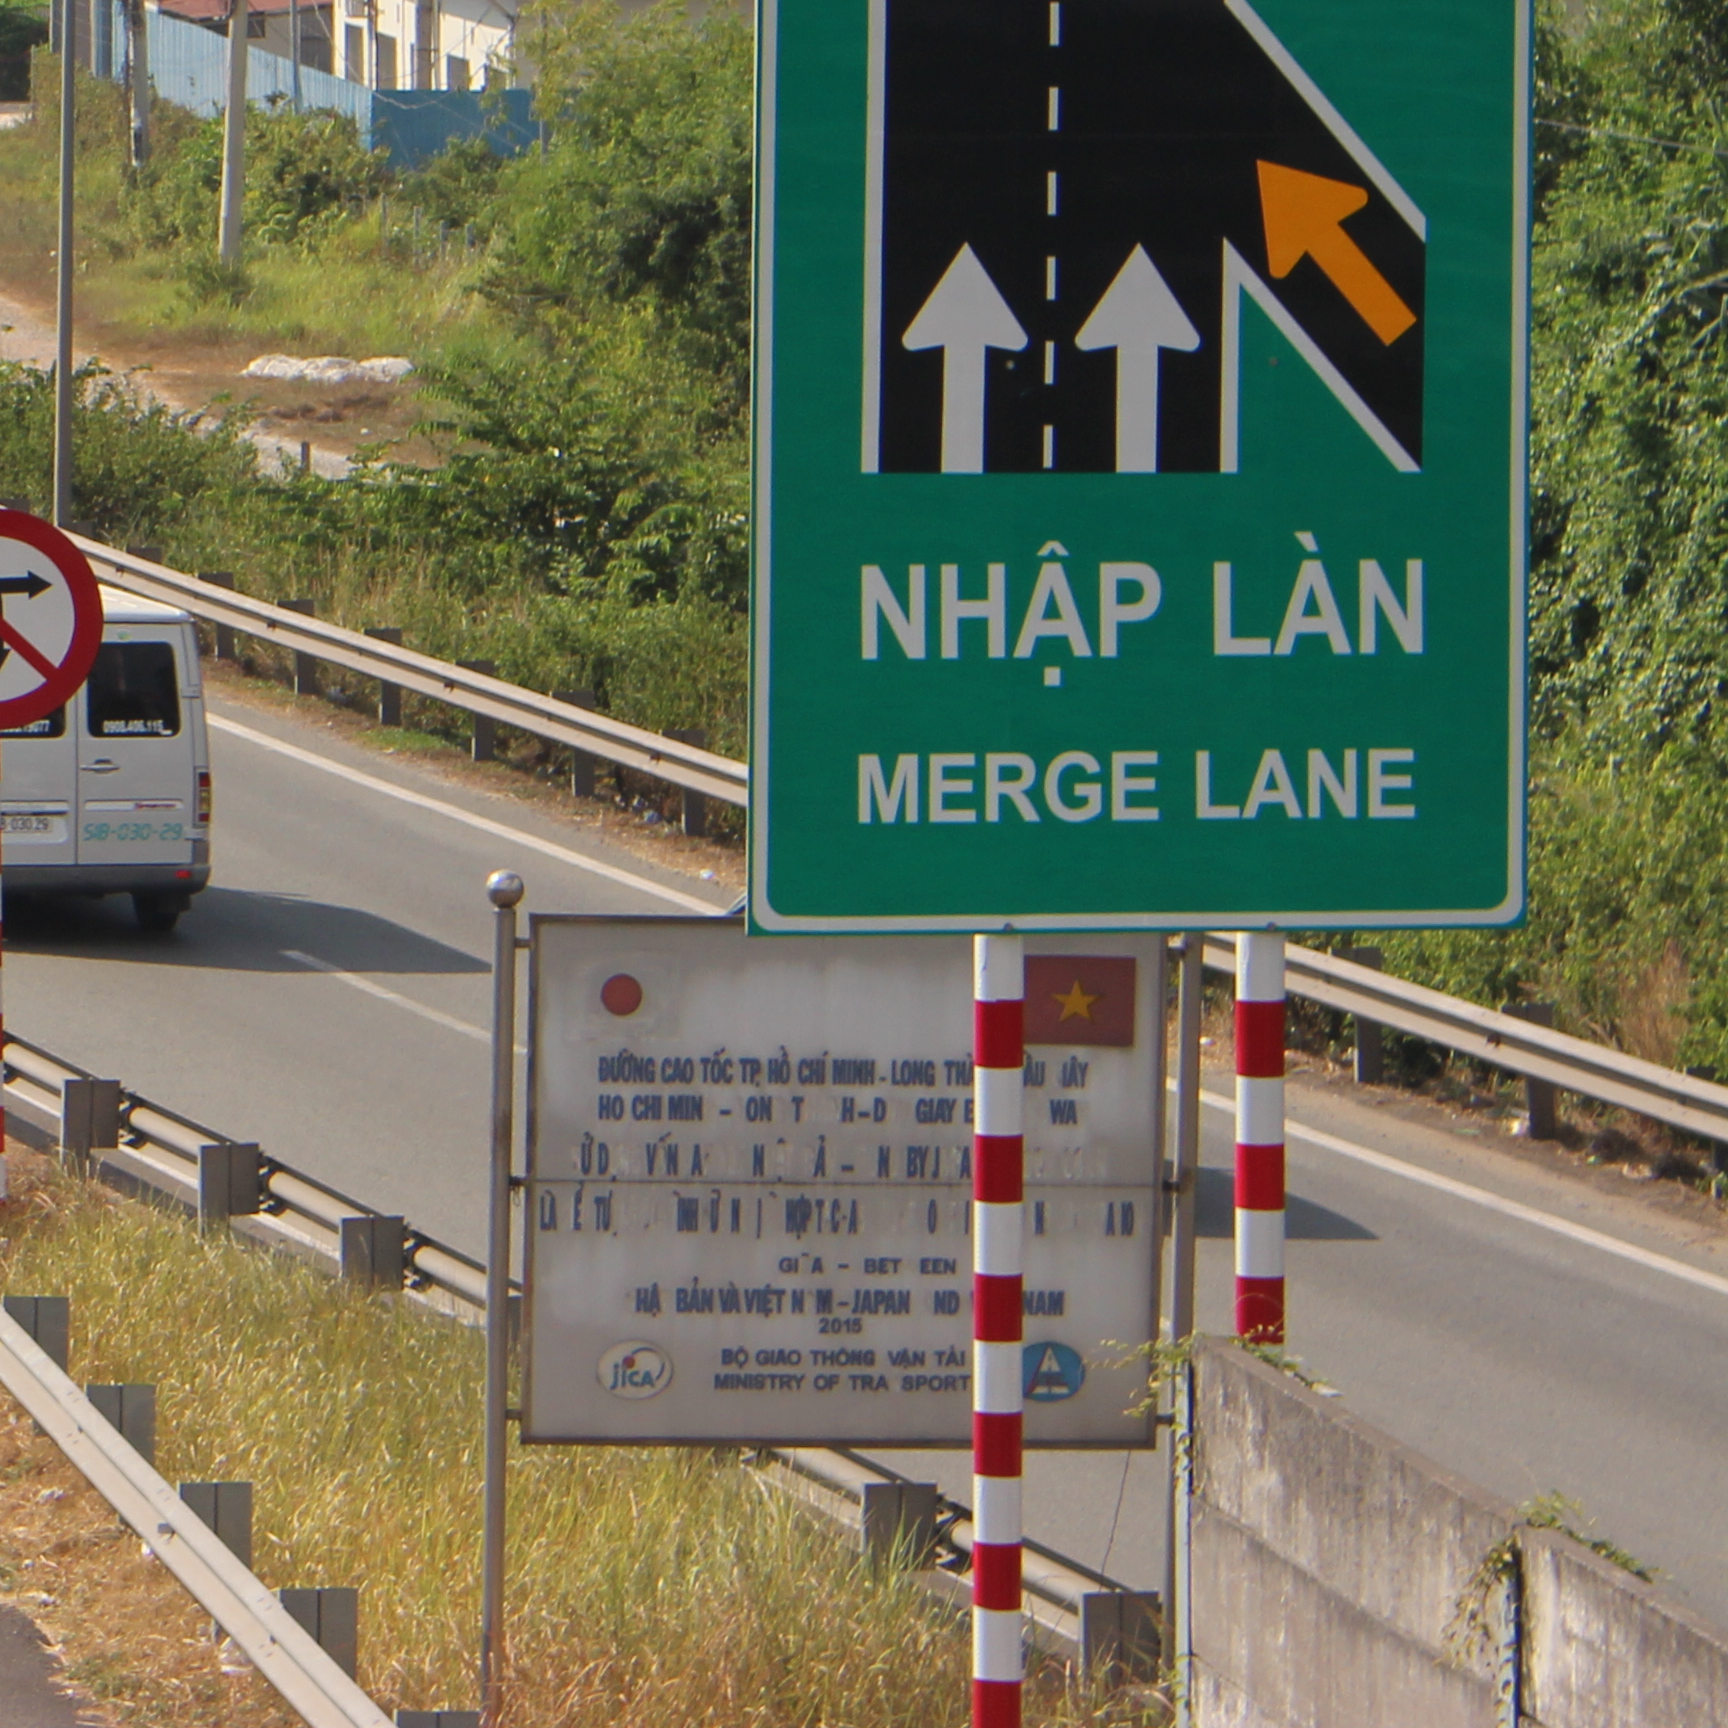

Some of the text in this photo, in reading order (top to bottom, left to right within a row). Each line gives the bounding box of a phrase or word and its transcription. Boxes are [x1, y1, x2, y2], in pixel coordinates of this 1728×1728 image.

[860, 531, 1424, 687] NHẬP LÀN
[856, 748, 1416, 824] MERGE LANE
[597, 1047, 656, 1084] ĐƯỜNG
[660, 1057, 694, 1084] CAO
[699, 1046, 734, 1084] TỐC
[766, 1045, 791, 1084] HỒ
[797, 1050, 827, 1086] CHÍ
[831, 1058, 875, 1086] MINH
[890, 1058, 936, 1087] LONG
[944, 1051, 975, 1087] THÀ
[598, 1094, 625, 1121] HO
[631, 1094, 663, 1121] CHI
[667, 1094, 704, 1121] MIN
[863, 1257, 957, 1275] BETEEN
[851, 1288, 911, 1315] JAPAN
[933, 1289, 960, 1315] ND
[818, 1316, 863, 1334] 2015
[720, 1346, 749, 1370] BỘ
[754, 1348, 803, 1366] GIAO
[809, 1344, 877, 1366] THÔNG
[887, 1347, 926, 1370] VẬN
[713, 1373, 972, 1393] MINISTRY OF TRASPORT
